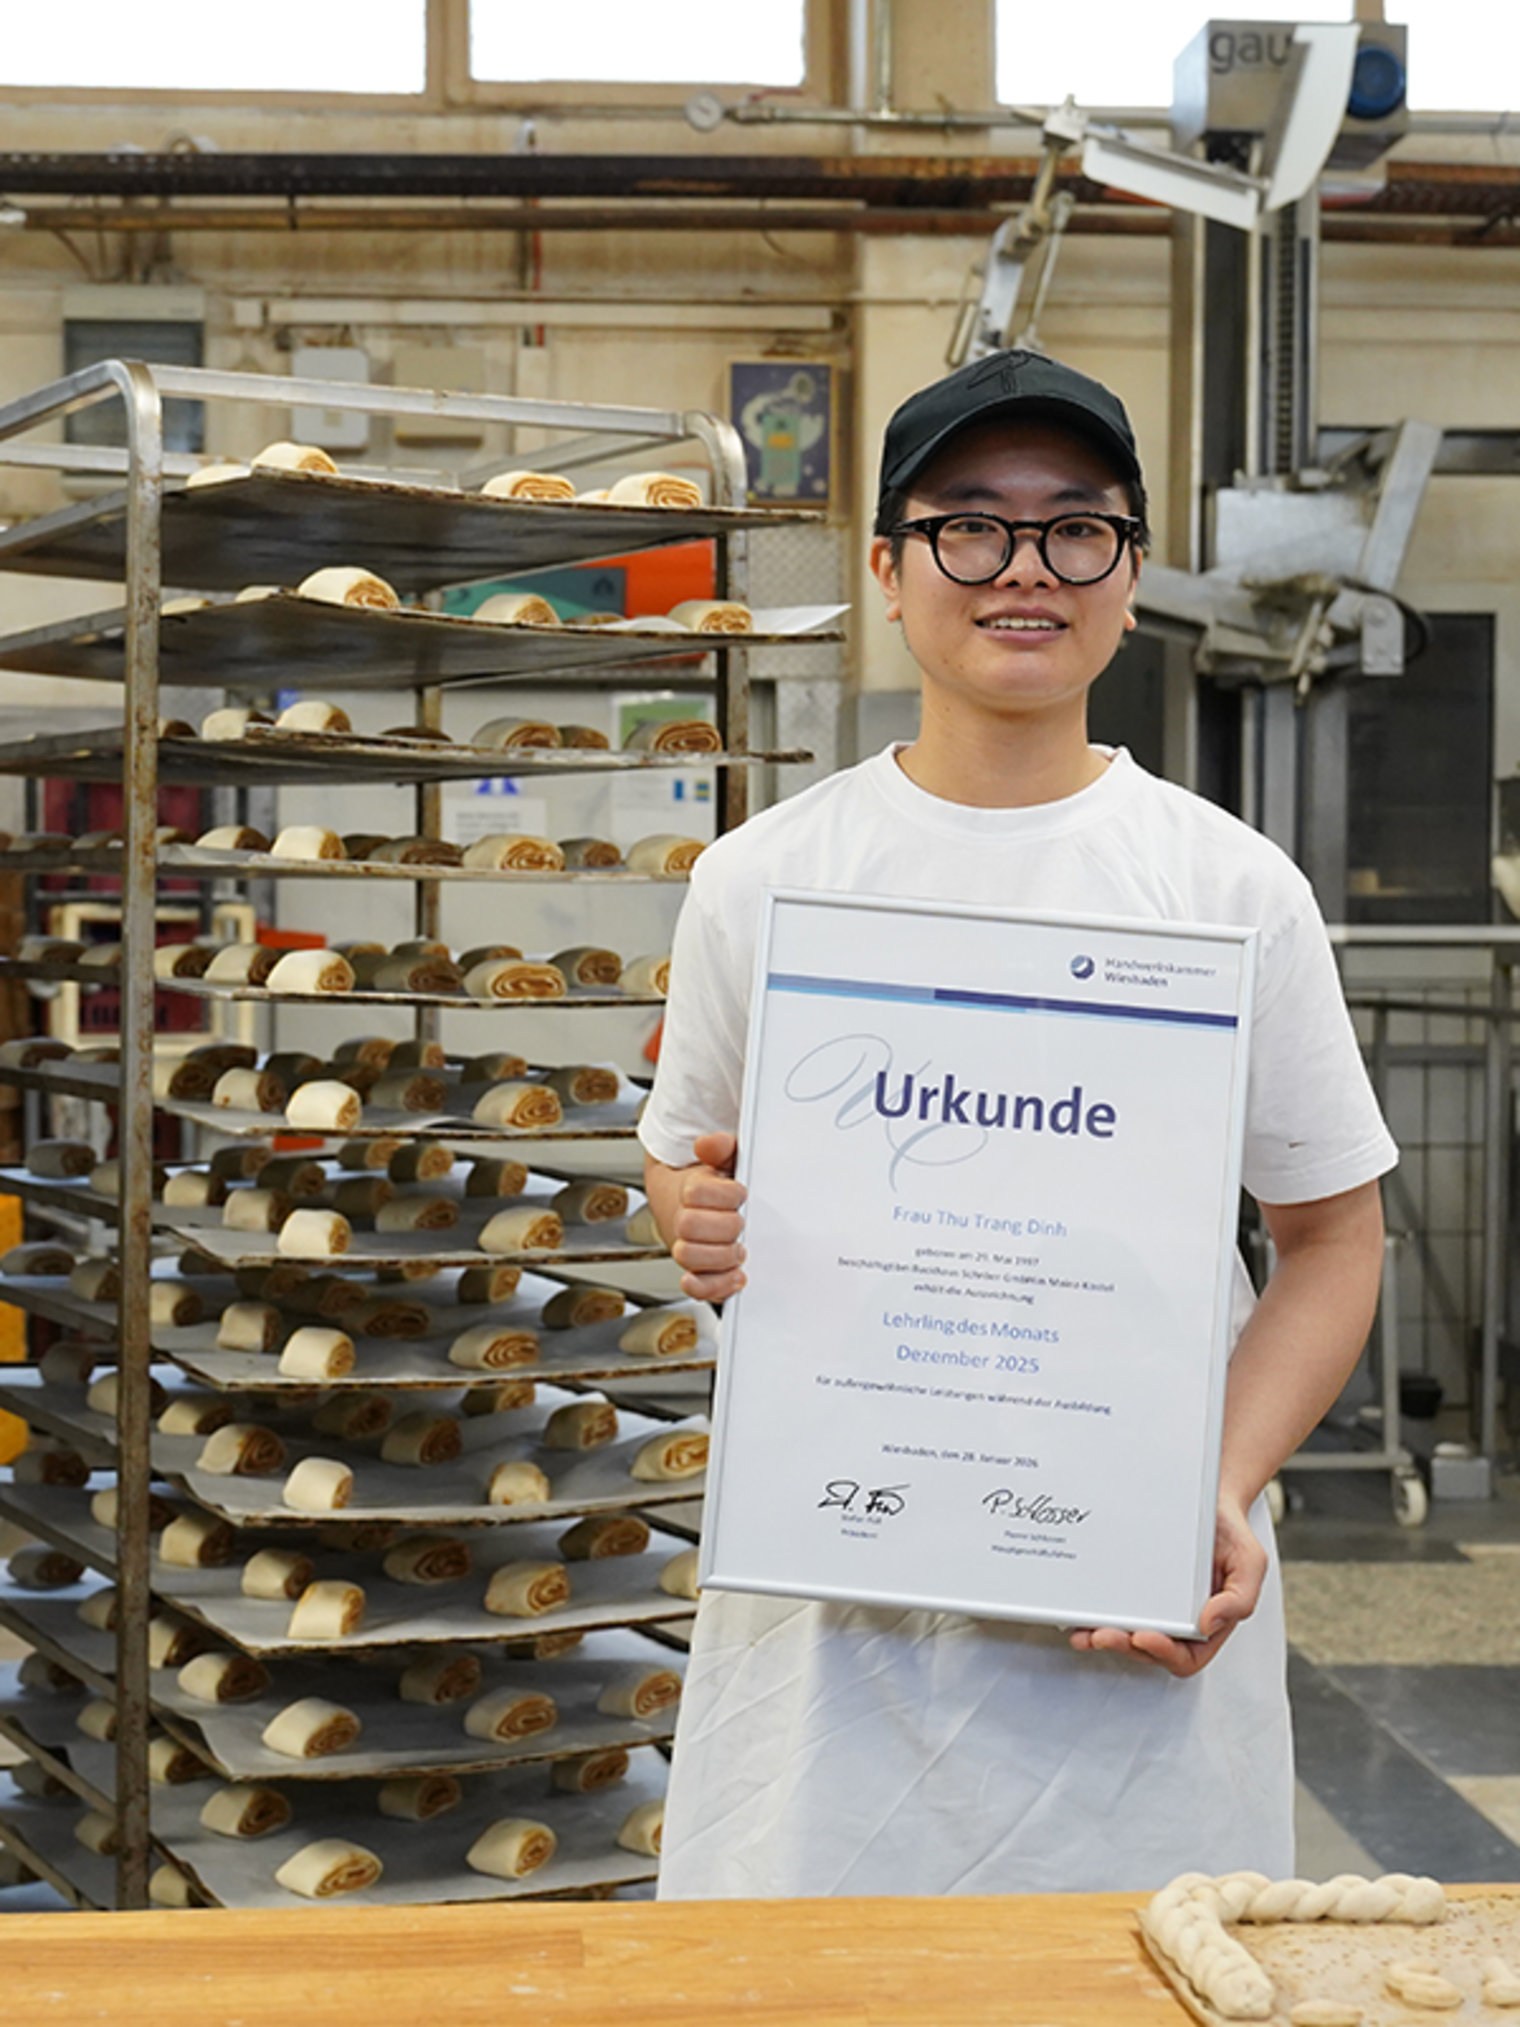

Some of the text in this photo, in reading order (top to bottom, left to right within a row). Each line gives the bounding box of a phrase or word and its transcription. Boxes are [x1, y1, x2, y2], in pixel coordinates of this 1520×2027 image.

[1105, 957, 1216, 978] Handwerkskammer
[1105, 971, 1168, 988] Wiesbaden
[874, 1070, 1117, 1138] Urkunde
[893, 1205, 1068, 1237] Frau Thu Trang Dinh
[882, 1311, 1060, 1344] Lehrling des Monats
[896, 1343, 1040, 1374] Dezember 2025
